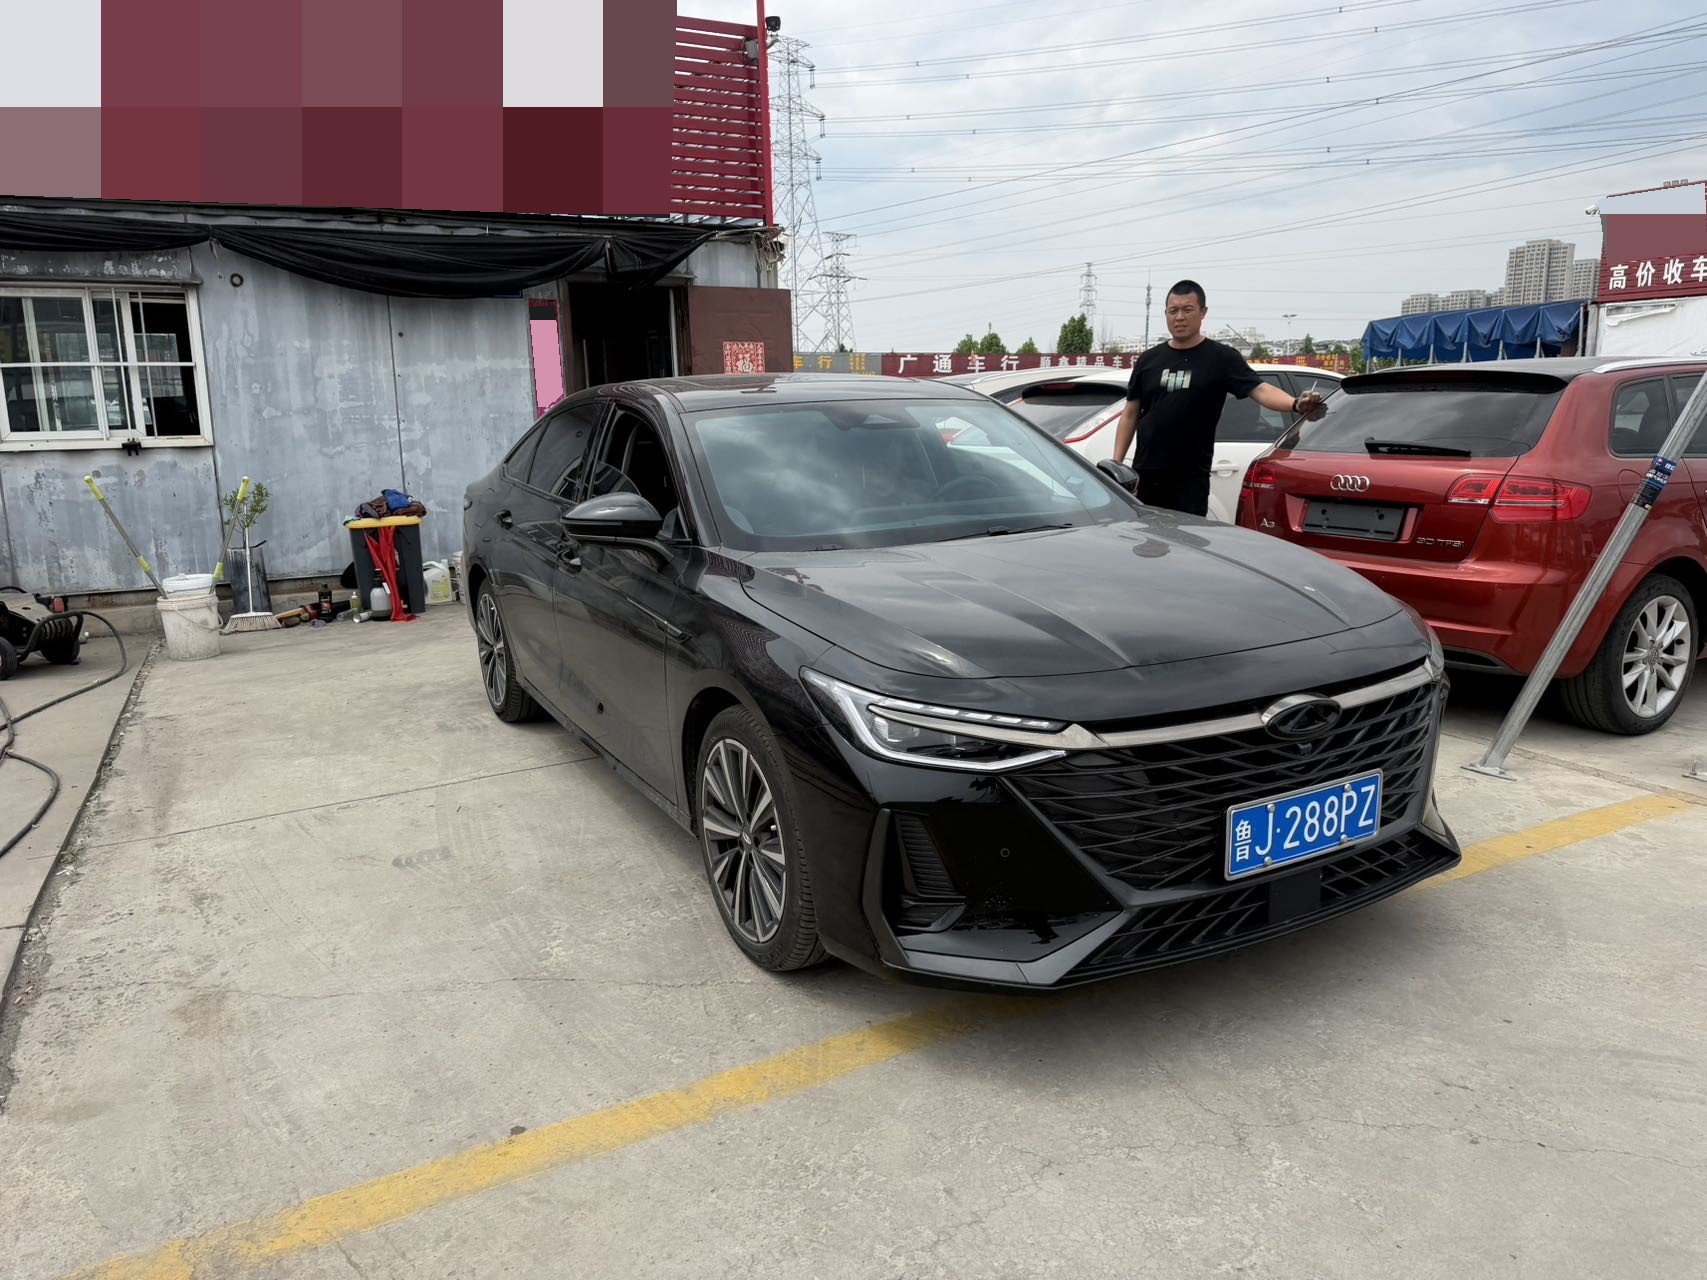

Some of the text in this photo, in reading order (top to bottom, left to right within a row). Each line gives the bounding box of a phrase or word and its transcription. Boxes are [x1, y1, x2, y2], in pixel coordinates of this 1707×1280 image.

[1608, 255, 1707, 290] 高价收车
[898, 354, 1020, 373] 广通车行
[1260, 518, 1275, 528] A3
[1234, 784, 1376, 863] 鲁J·288PZ
